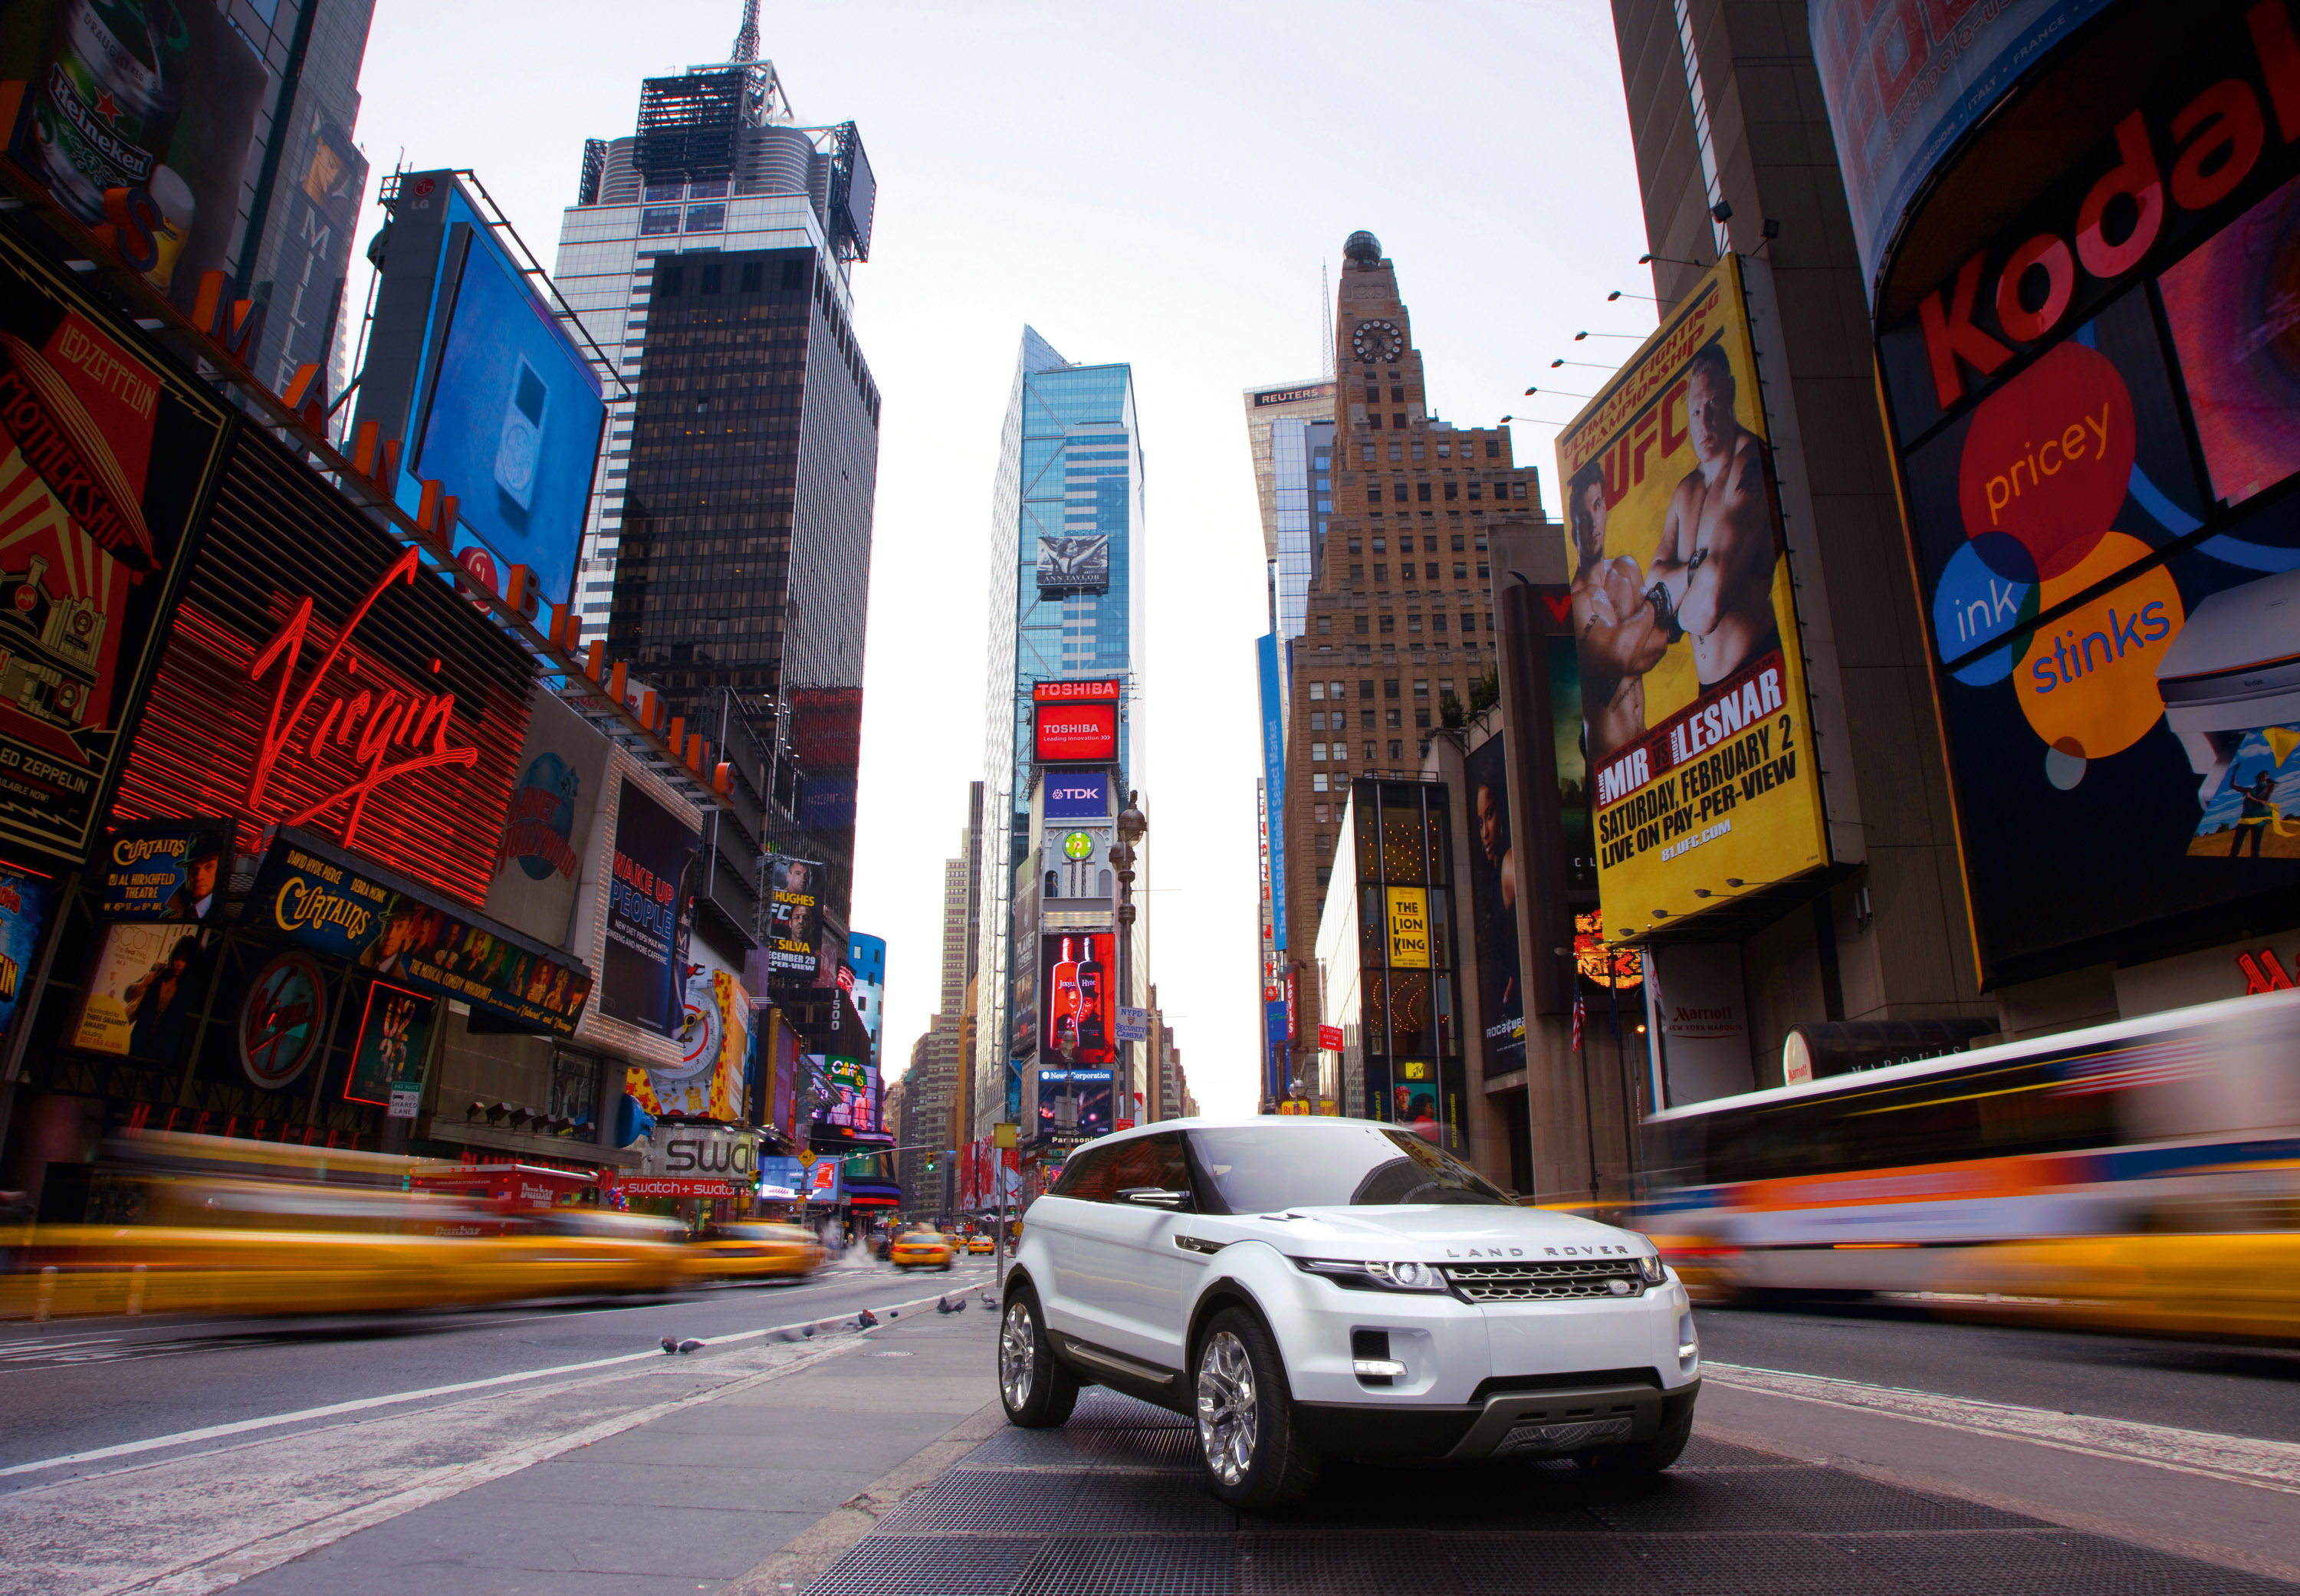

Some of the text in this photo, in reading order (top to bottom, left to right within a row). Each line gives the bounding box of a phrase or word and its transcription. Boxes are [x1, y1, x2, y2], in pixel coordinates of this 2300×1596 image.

[84, 13, 144, 82] DRAUGHT KEG
[2013, 14, 2068, 65] FRANCE
[1967, 77, 1999, 110] ITALY
[54, 78, 151, 174] Heineken
[1916, 122, 1957, 174] KINGDOM
[411, 199, 429, 210] LG
[1564, 291, 1719, 460] ULTIMATE FIGHTING
[1262, 388, 1319, 404] REUTERS
[1572, 323, 1705, 472] CHAMPIONSHIP
[1604, 379, 1687, 512] UFC
[0, 369, 135, 550] MOTHERSHIP
[1986, 402, 2110, 525] pricey
[1955, 577, 2018, 642] ink
[2032, 599, 2171, 694] stinks
[251, 544, 478, 849] Virgin
[507, 564, 735, 802] BUILDING
[1037, 682, 1114, 696] TOSHIBA
[1629, 727, 1658, 753] CHAMP
[1671, 691, 1719, 727] WRESTLING
[1720, 655, 1776, 695] SUPERSTAR
[1043, 724, 1099, 734] TOSHIBA
[1268, 718, 1279, 764] Market
[1603, 747, 1651, 803] MIR
[1653, 741, 1669, 767] VS
[1670, 728, 1680, 766] BROCK
[1676, 668, 1783, 763] LESNAR
[24, 757, 90, 795] ZEPPELIN
[1271, 766, 1281, 806] Select
[1598, 714, 1794, 845] SATURDAY, FEBRUARY 2
[30, 790, 50, 803] NOW!
[1063, 788, 1099, 799] TDK
[1602, 750, 1796, 870] LIVE ON PAY-PER-VIEW
[1274, 809, 1284, 850] Global
[113, 839, 188, 866] CURTAINS
[118, 873, 176, 885] AL HIRSCHFELD
[286, 849, 388, 904] DAVID HYDE PIERCE DEBRA MONK
[613, 849, 675, 907] WAKE UP
[1275, 855, 1286, 907] NASDAQ
[125, 886, 159, 899] THEATRE
[775, 892, 815, 906] HUGHES
[275, 876, 372, 940] CURTAINS
[610, 878, 673, 940] PEOPLE
[1396, 901, 1418, 913] THE
[615, 919, 669, 954] NEW DIET PEPSI MAX WITH
[1393, 916, 1424, 934] LION
[111, 924, 164, 954] SCOTT
[606, 927, 648, 955] GINSENG AND MORE
[778, 939, 810, 954] SILVA
[1017, 931, 1035, 957] PLANET
[1394, 938, 1424, 957] KING
[805, 956, 816, 965] 29
[409, 959, 492, 1001] THE MUSICAL COMEDY WHODUNIT
[1058, 978, 1096, 989] JEKYLL HYDE
[86, 1013, 127, 1028] THREE GRAMMY
[831, 989, 840, 1030] 1500
[1121, 1008, 1142, 1017] NYPD
[1674, 1006, 1732, 1022] Marriott
[83, 1021, 107, 1031] AWARDS
[1116, 1023, 1145, 1033] SECURITY
[1116, 1030, 1143, 1039] CAMERA
[1326, 1027, 1342, 1036] STOPPING
[79, 1036, 93, 1044] BEST
[1071, 1072, 1110, 1080] Corporation
[1405, 1062, 1424, 1079] MTV
[1283, 1105, 1307, 1115] BUBA
[520, 1182, 554, 1200] Dunbar
[629, 1182, 680, 1195] swatch
[435, 1226, 481, 1237] Dunbar
[1446, 1245, 1629, 1258] LAND ROVER
